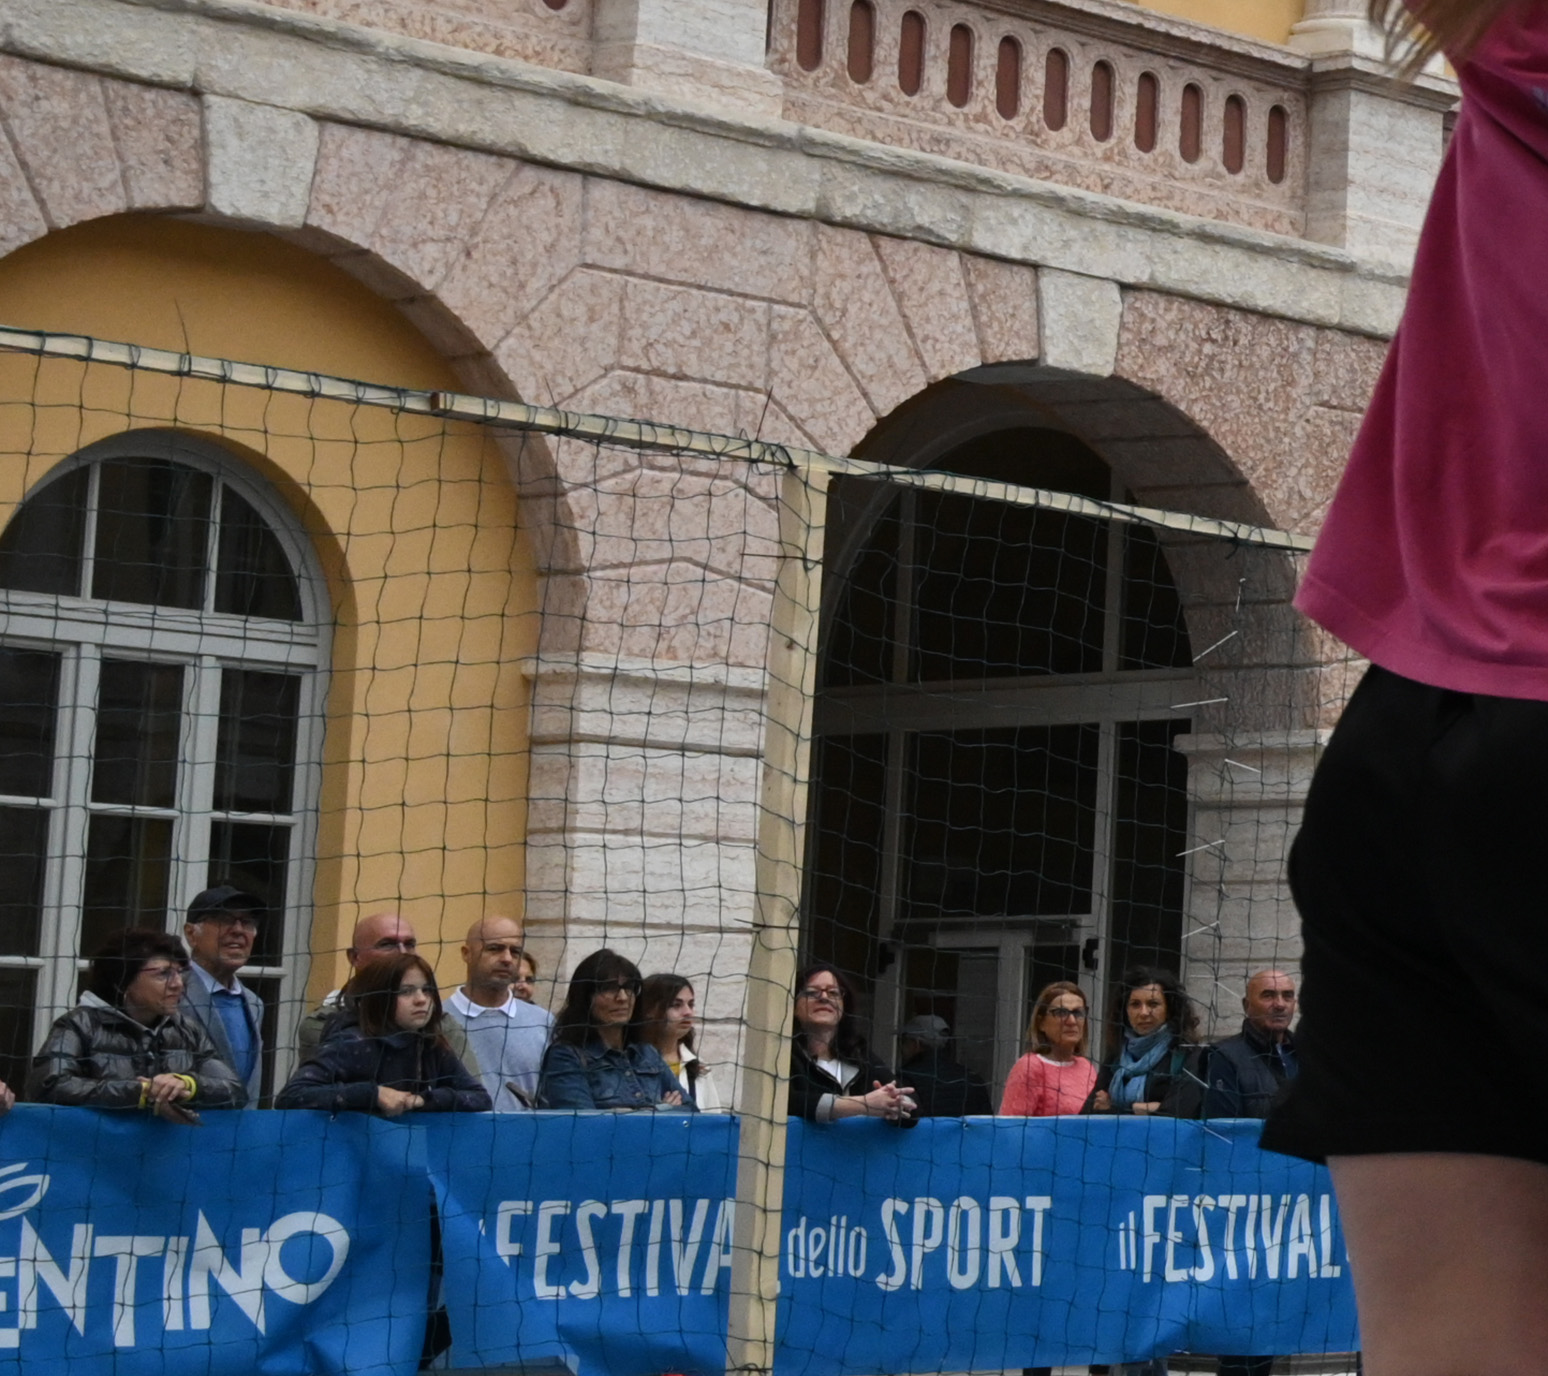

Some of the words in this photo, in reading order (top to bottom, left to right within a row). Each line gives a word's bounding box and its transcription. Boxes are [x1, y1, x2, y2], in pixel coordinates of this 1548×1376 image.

[496, 1198, 736, 1300] FESTIVA
[787, 1215, 867, 1278] dello
[875, 1195, 1052, 1292] SPORT
[1143, 1193, 1341, 1283] FESTIVAL
